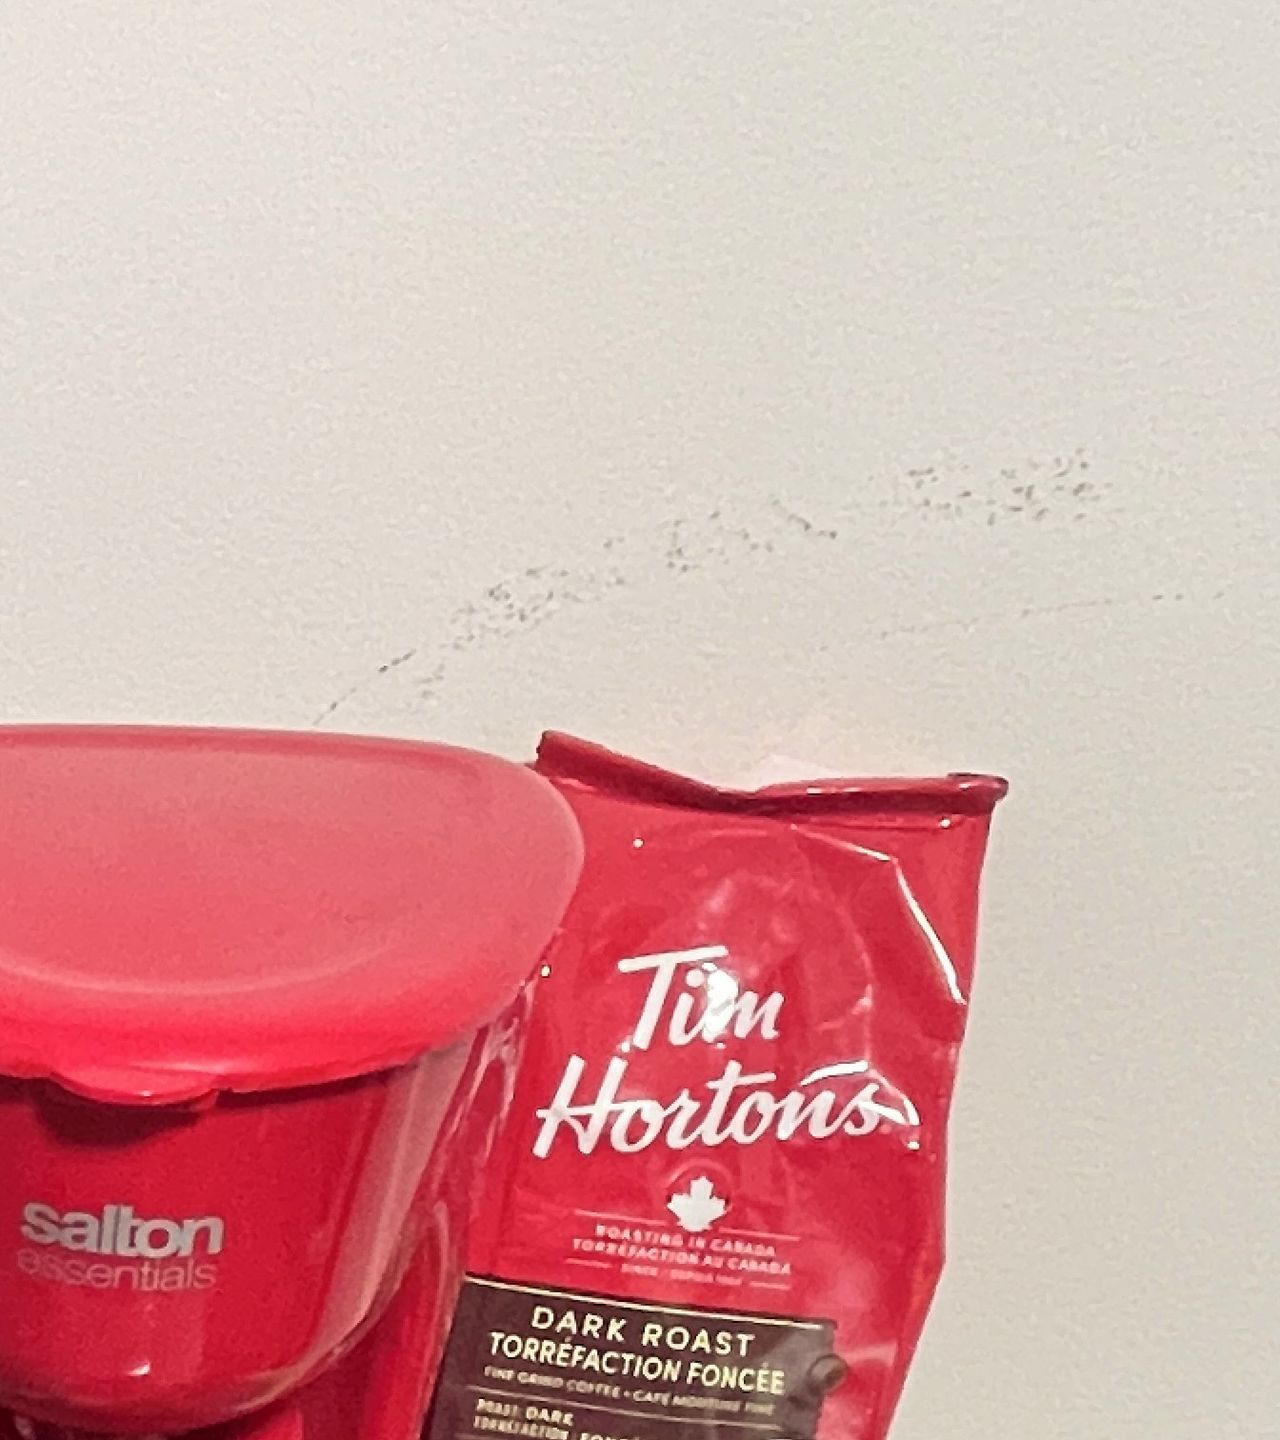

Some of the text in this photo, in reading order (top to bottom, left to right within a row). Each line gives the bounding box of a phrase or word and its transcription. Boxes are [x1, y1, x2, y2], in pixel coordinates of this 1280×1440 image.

[617, 944, 785, 1052] Tim
[532, 1054, 881, 1159] Hortons
[21, 1202, 225, 1258] salton
[595, 1223, 684, 1248] ROASTING
[709, 1238, 776, 1257] CANADA
[17, 1248, 218, 1291] essentials
[531, 1305, 756, 1358] DARK ROAST
[488, 1331, 786, 1396] TORRÉFACTION FONCÉE
[525, 1406, 575, 1426] DARK
